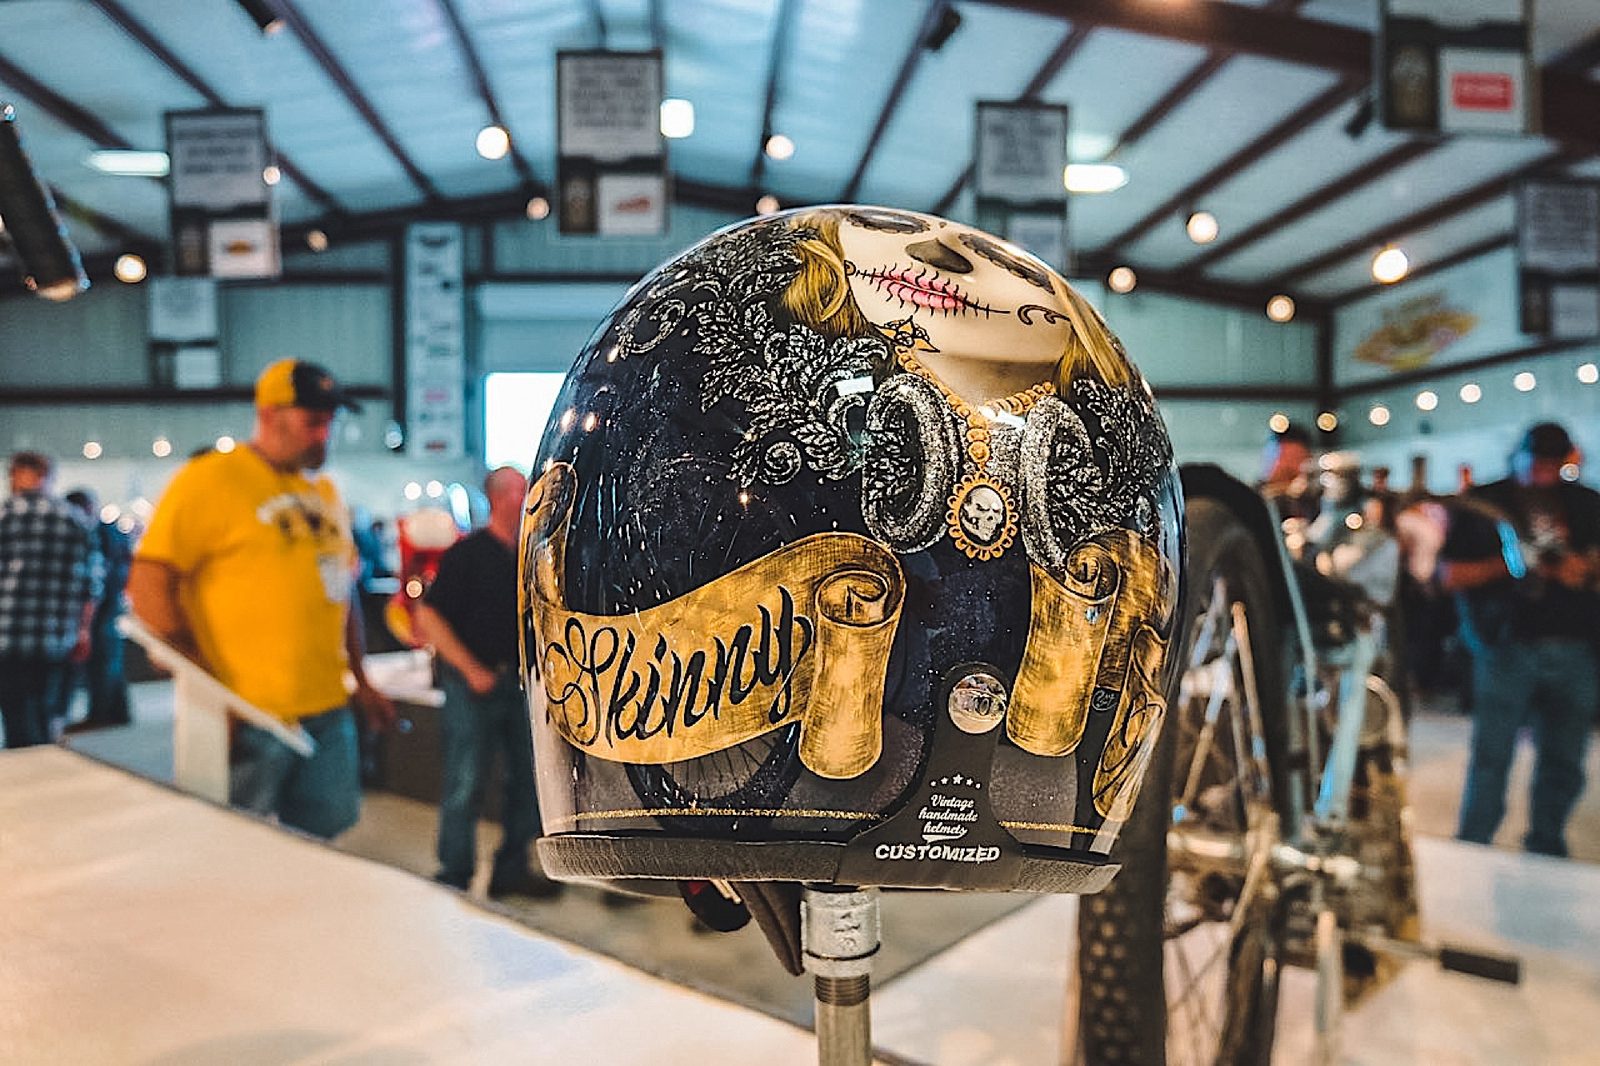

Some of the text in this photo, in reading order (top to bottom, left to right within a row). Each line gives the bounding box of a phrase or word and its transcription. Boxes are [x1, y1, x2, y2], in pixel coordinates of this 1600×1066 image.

[544, 584, 814, 748] Skinny
[930, 794, 975, 811] Vintage
[918, 807, 979, 822] handmade
[923, 821, 968, 838] helmets
[875, 843, 1001, 863] CUSTOMIZED
